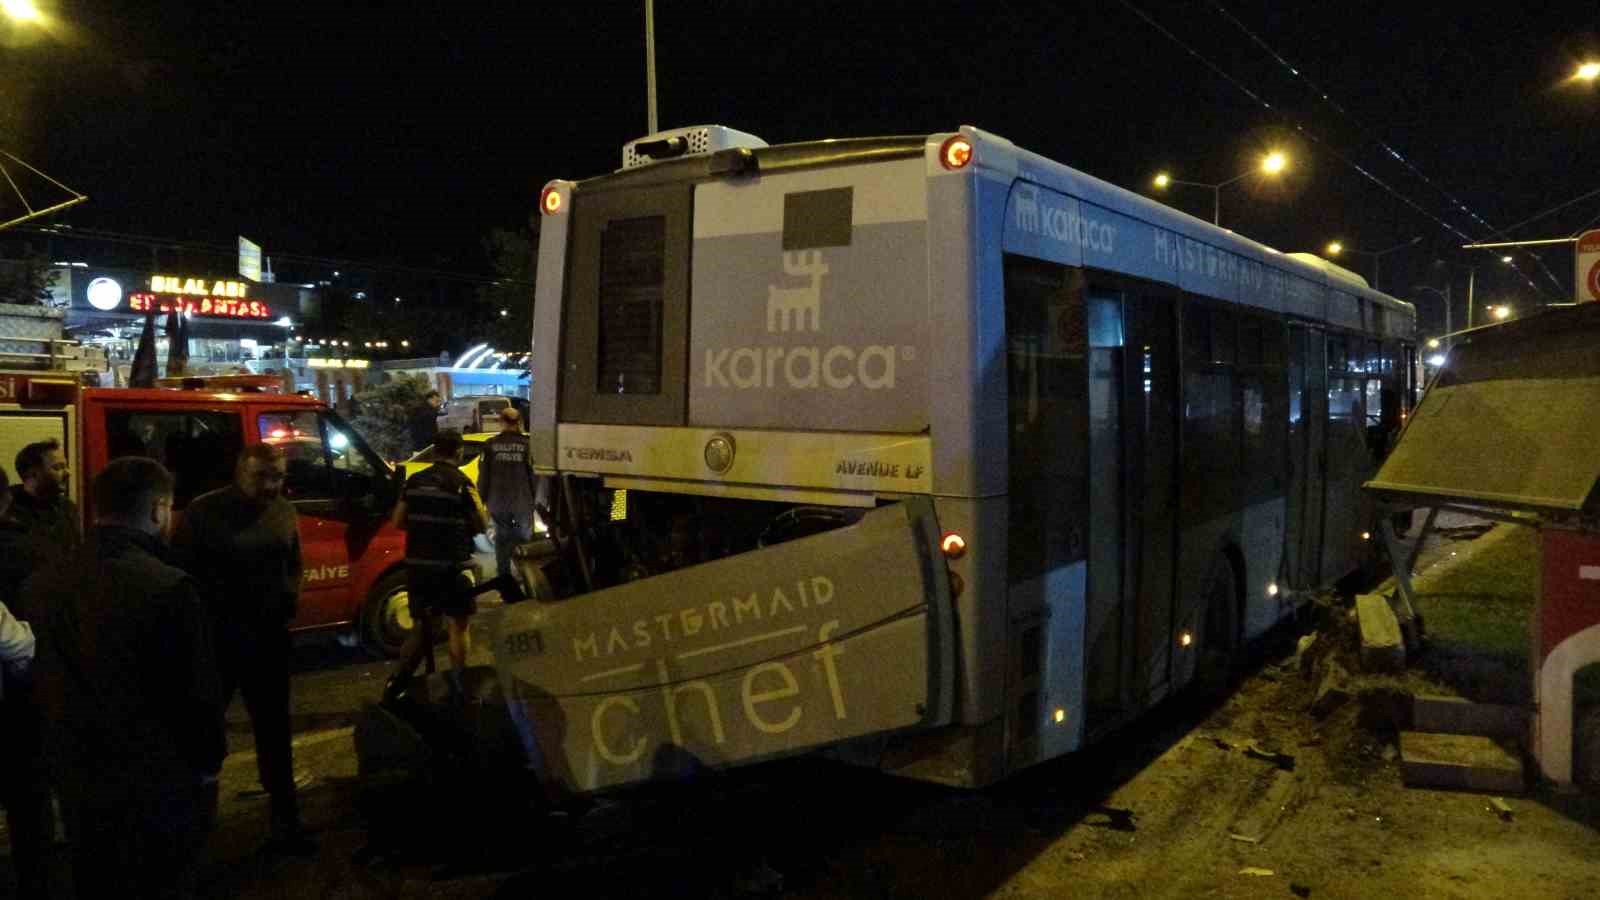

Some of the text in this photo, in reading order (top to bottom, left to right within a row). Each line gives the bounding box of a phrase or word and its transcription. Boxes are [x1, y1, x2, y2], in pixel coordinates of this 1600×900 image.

[1040, 205, 1113, 254] karaca
[704, 344, 897, 389] karaca
[564, 447, 633, 462] TEMSA
[836, 460, 925, 479] AVENUE LF
[591, 619, 847, 765] chef
